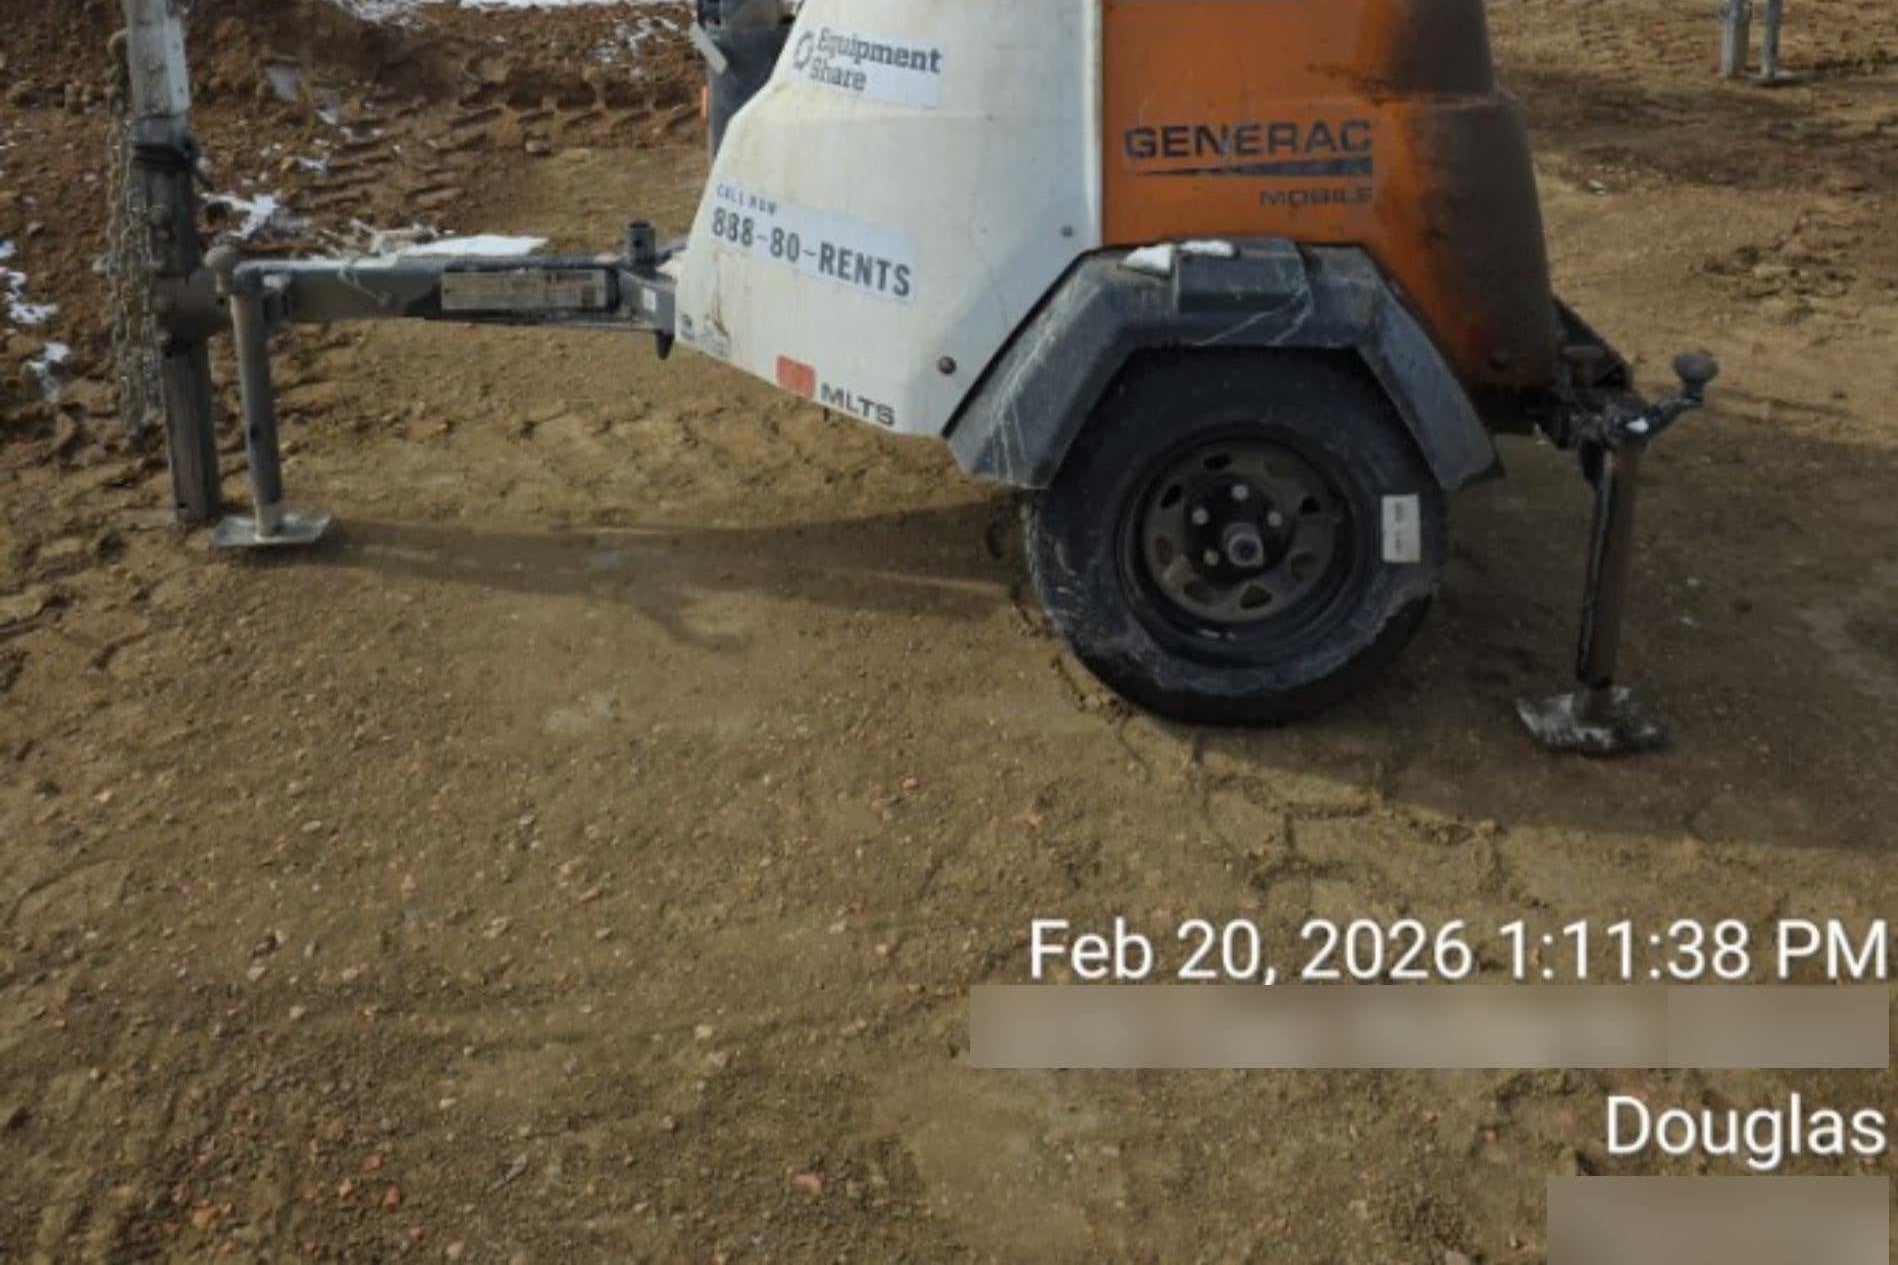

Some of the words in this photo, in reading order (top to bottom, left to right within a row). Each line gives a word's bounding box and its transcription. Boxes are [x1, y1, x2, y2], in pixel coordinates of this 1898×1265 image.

[817, 28, 942, 74] Equipment
[808, 55, 867, 91] Share
[1124, 119, 1373, 159] GENERAC
[1259, 187, 1373, 206] MOBILE
[711, 206, 911, 297] 888-80-RENTS
